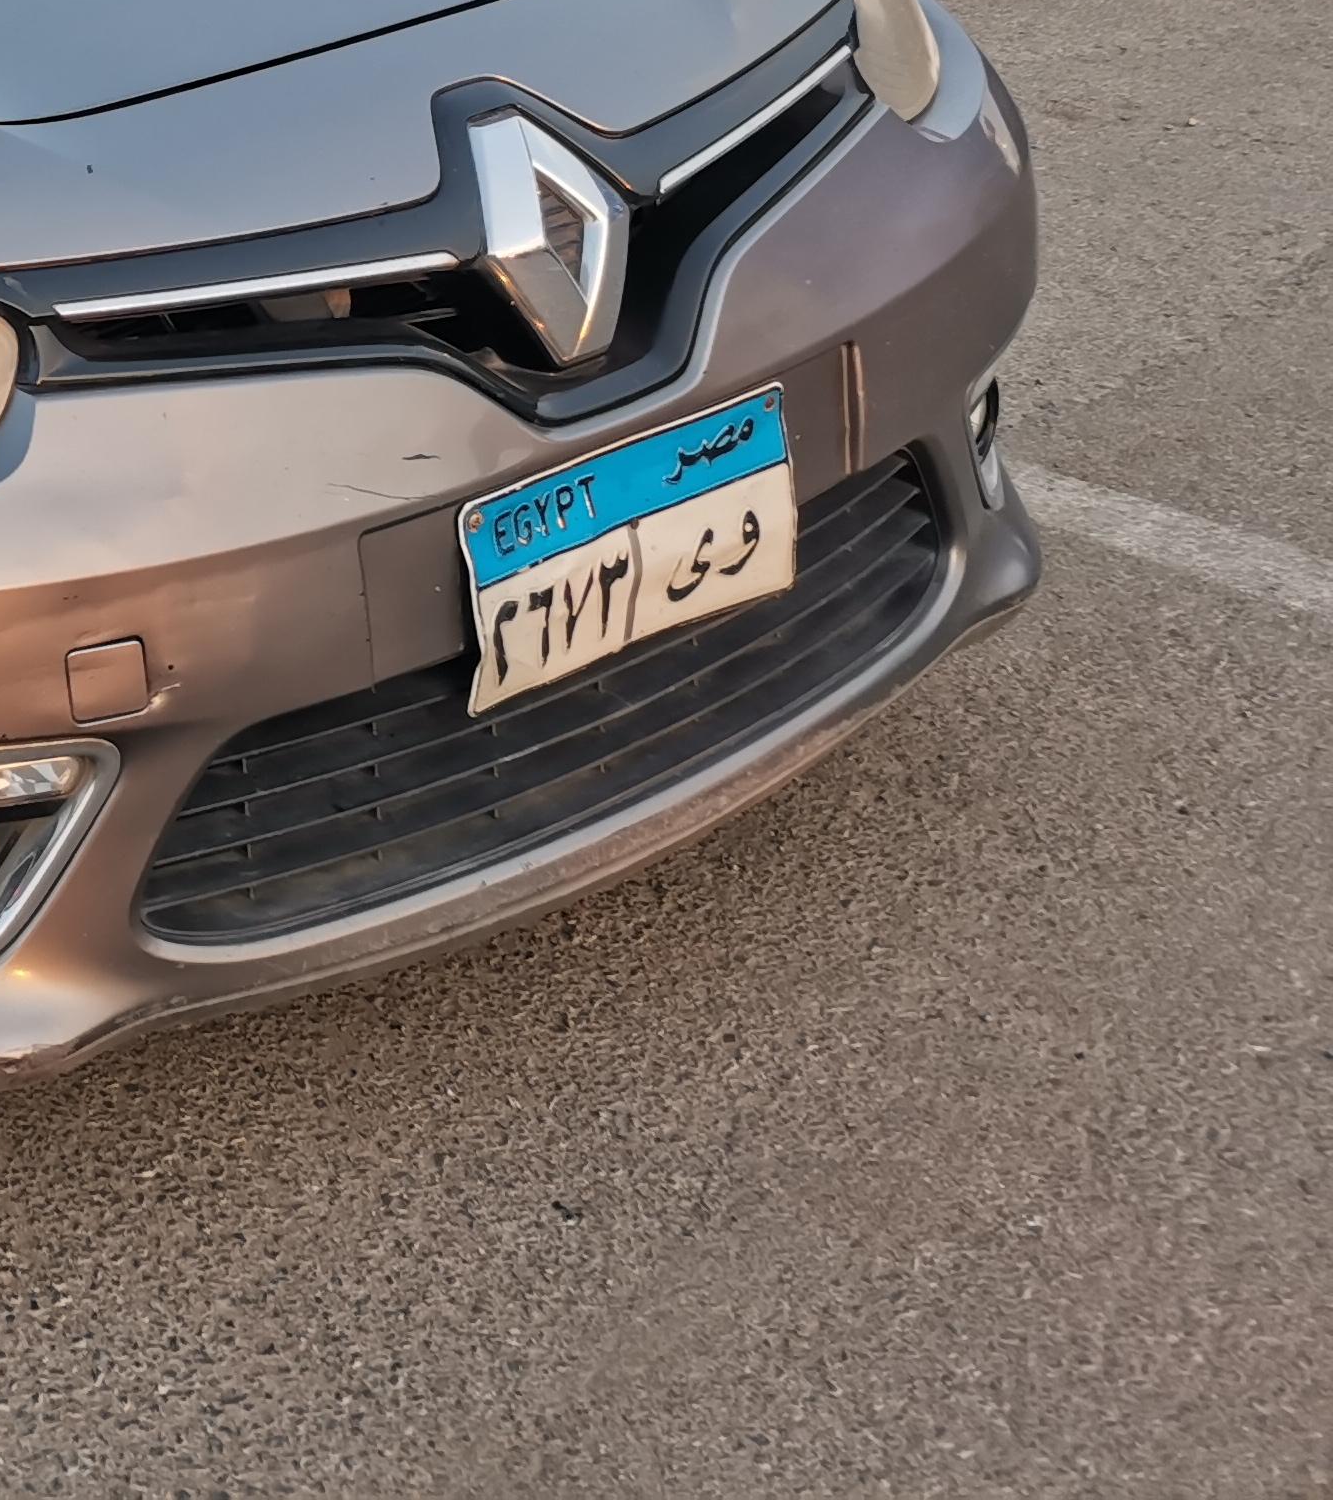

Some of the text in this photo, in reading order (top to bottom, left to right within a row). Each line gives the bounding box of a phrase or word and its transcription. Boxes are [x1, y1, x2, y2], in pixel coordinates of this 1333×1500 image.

[662, 414, 754, 485] مصر
[493, 473, 597, 557] EGYPT
[492, 550, 631, 687] ٢٦٧٣
